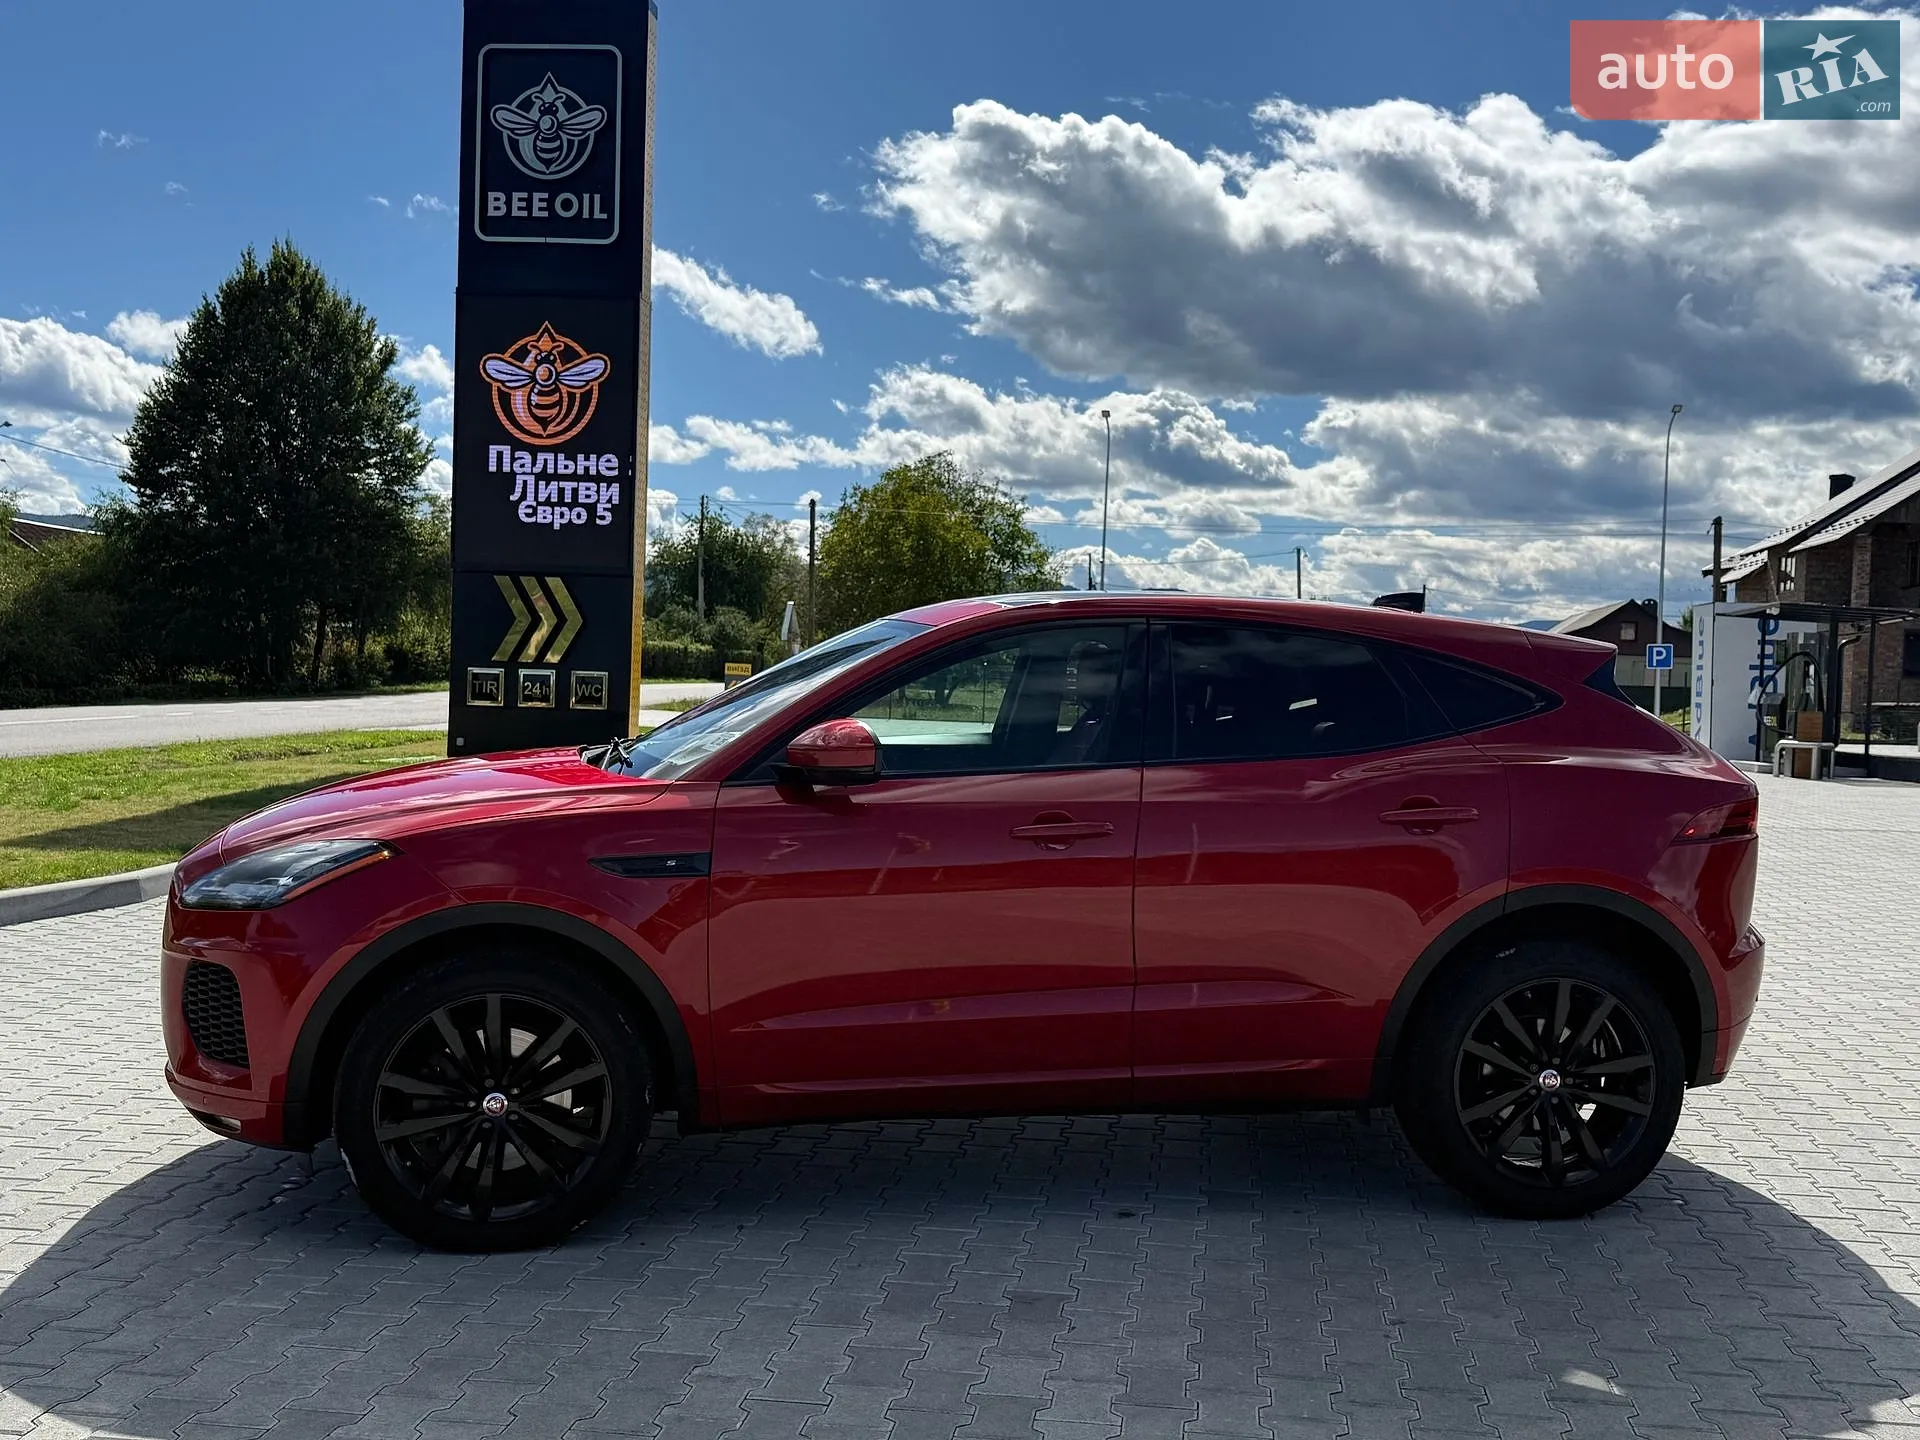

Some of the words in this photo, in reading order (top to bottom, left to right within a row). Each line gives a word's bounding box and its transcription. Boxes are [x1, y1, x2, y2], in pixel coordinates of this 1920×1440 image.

[487, 192, 549, 217] BEE
[555, 193, 608, 219] OIL
[488, 445, 619, 476] Пальне
[509, 475, 620, 504] Литви
[518, 500, 588, 530] Євро
[596, 503, 612, 525] 5
[1652, 647, 1667, 666] P
[473, 681, 498, 694] TIR
[576, 684, 602, 697] WC
